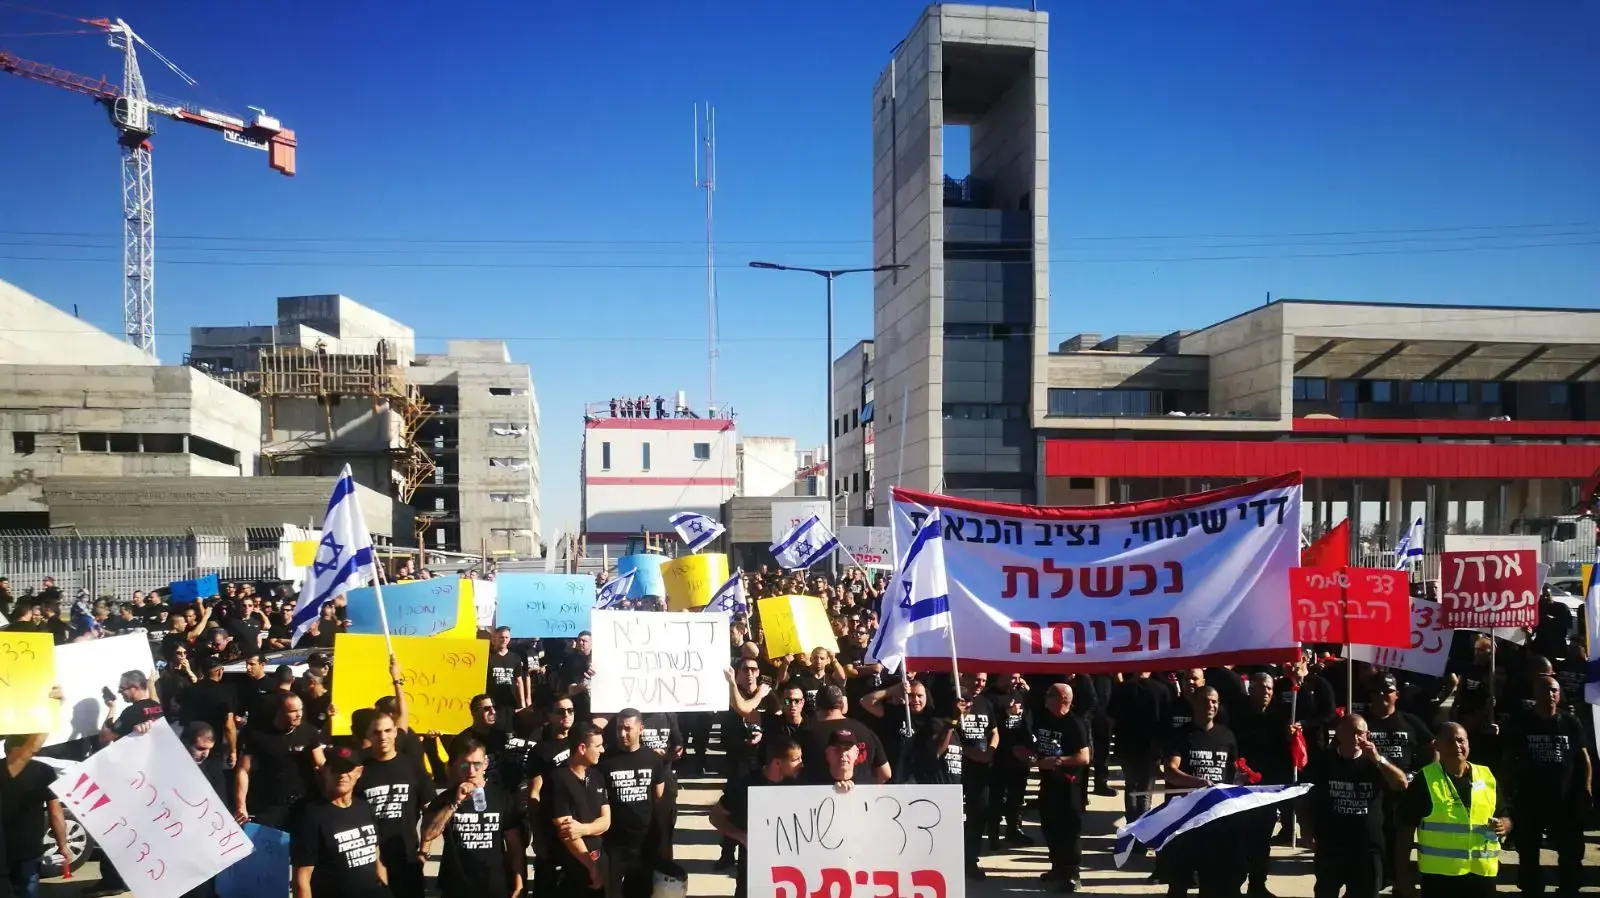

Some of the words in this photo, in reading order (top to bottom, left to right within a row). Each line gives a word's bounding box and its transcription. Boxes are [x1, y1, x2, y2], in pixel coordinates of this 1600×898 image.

[910, 511, 1023, 546] הכבאת
[1122, 508, 1228, 550] שימחי,
[1236, 495, 1289, 528] דדי
[1034, 522, 1101, 547] נציב
[1001, 557, 1184, 600] נכשלת
[1453, 552, 1523, 591] ארדן
[1297, 598, 1392, 623] הביתה
[1443, 589, 1536, 613] תתעורר
[664, 620, 719, 646] דדי
[1009, 616, 1181, 656] הביתה
[624, 650, 704, 673] משחקים
[130, 770, 184, 838] חקירה
[172, 787, 245, 857] ועדת
[864, 795, 943, 856] דדי
